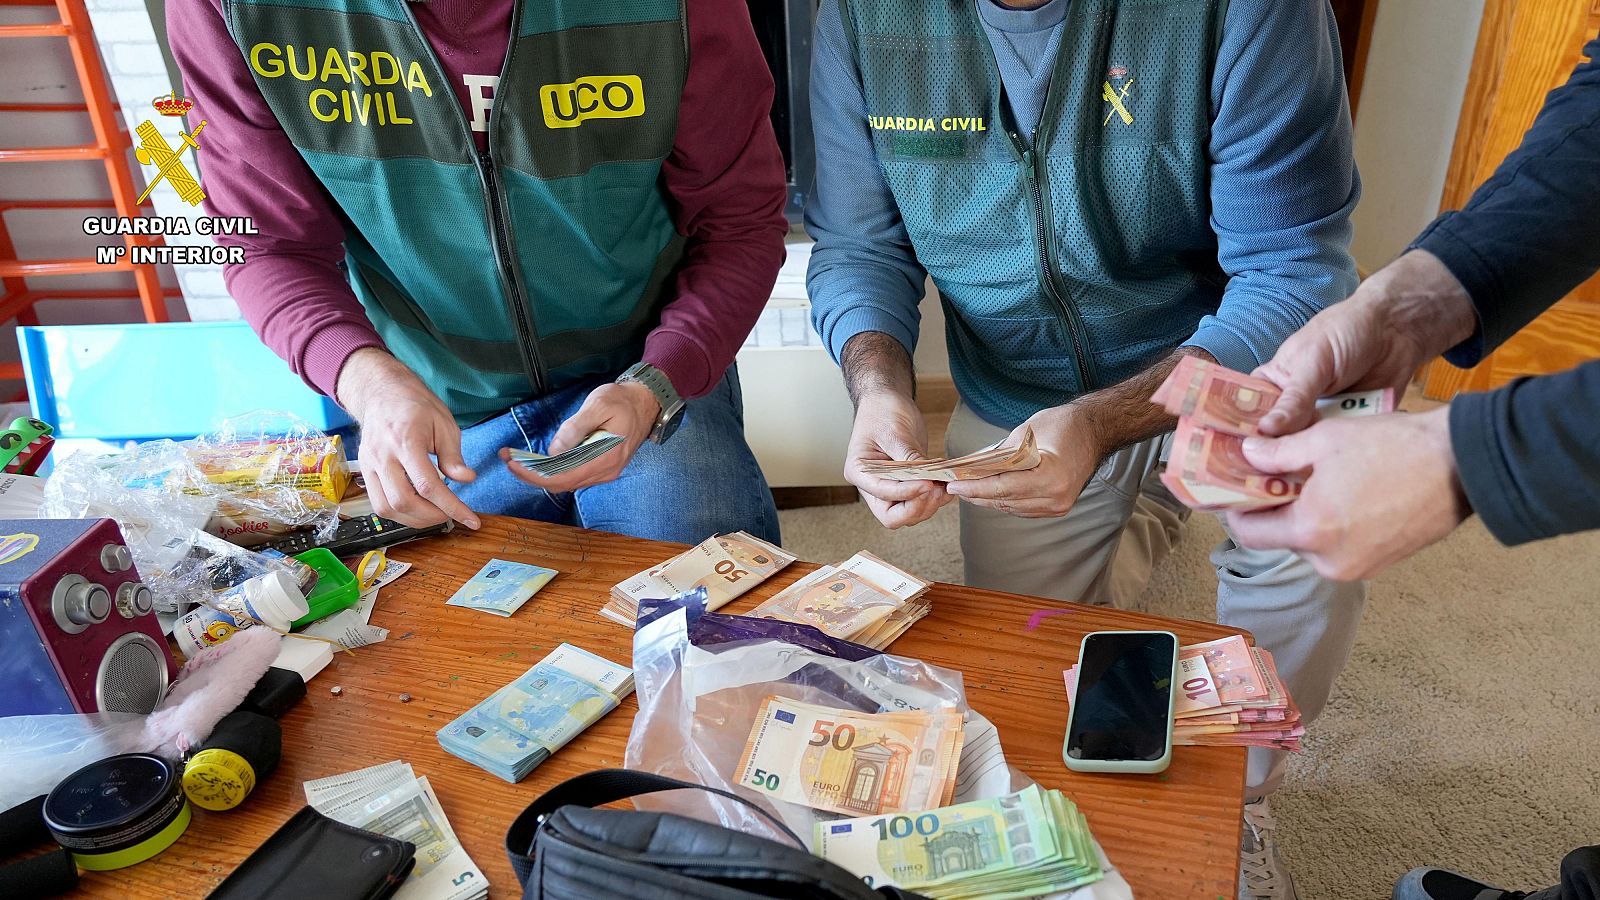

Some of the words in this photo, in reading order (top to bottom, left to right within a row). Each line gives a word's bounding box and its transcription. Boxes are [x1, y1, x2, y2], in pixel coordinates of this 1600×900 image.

[250, 42, 433, 98] GUARDIA
[308, 88, 413, 126] CIVIL
[550, 81, 634, 122] UCO
[941, 117, 986, 131] CIVIL
[1341, 398, 1369, 410] 10
[714, 559, 749, 584] 50
[1182, 677, 1212, 701] 10
[808, 719, 856, 752] 50
[751, 768, 780, 791] 50
[813, 781, 841, 792] EURO
[870, 813, 940, 841] 100
[452, 871, 474, 887] 5
[892, 863, 923, 873] EURO
